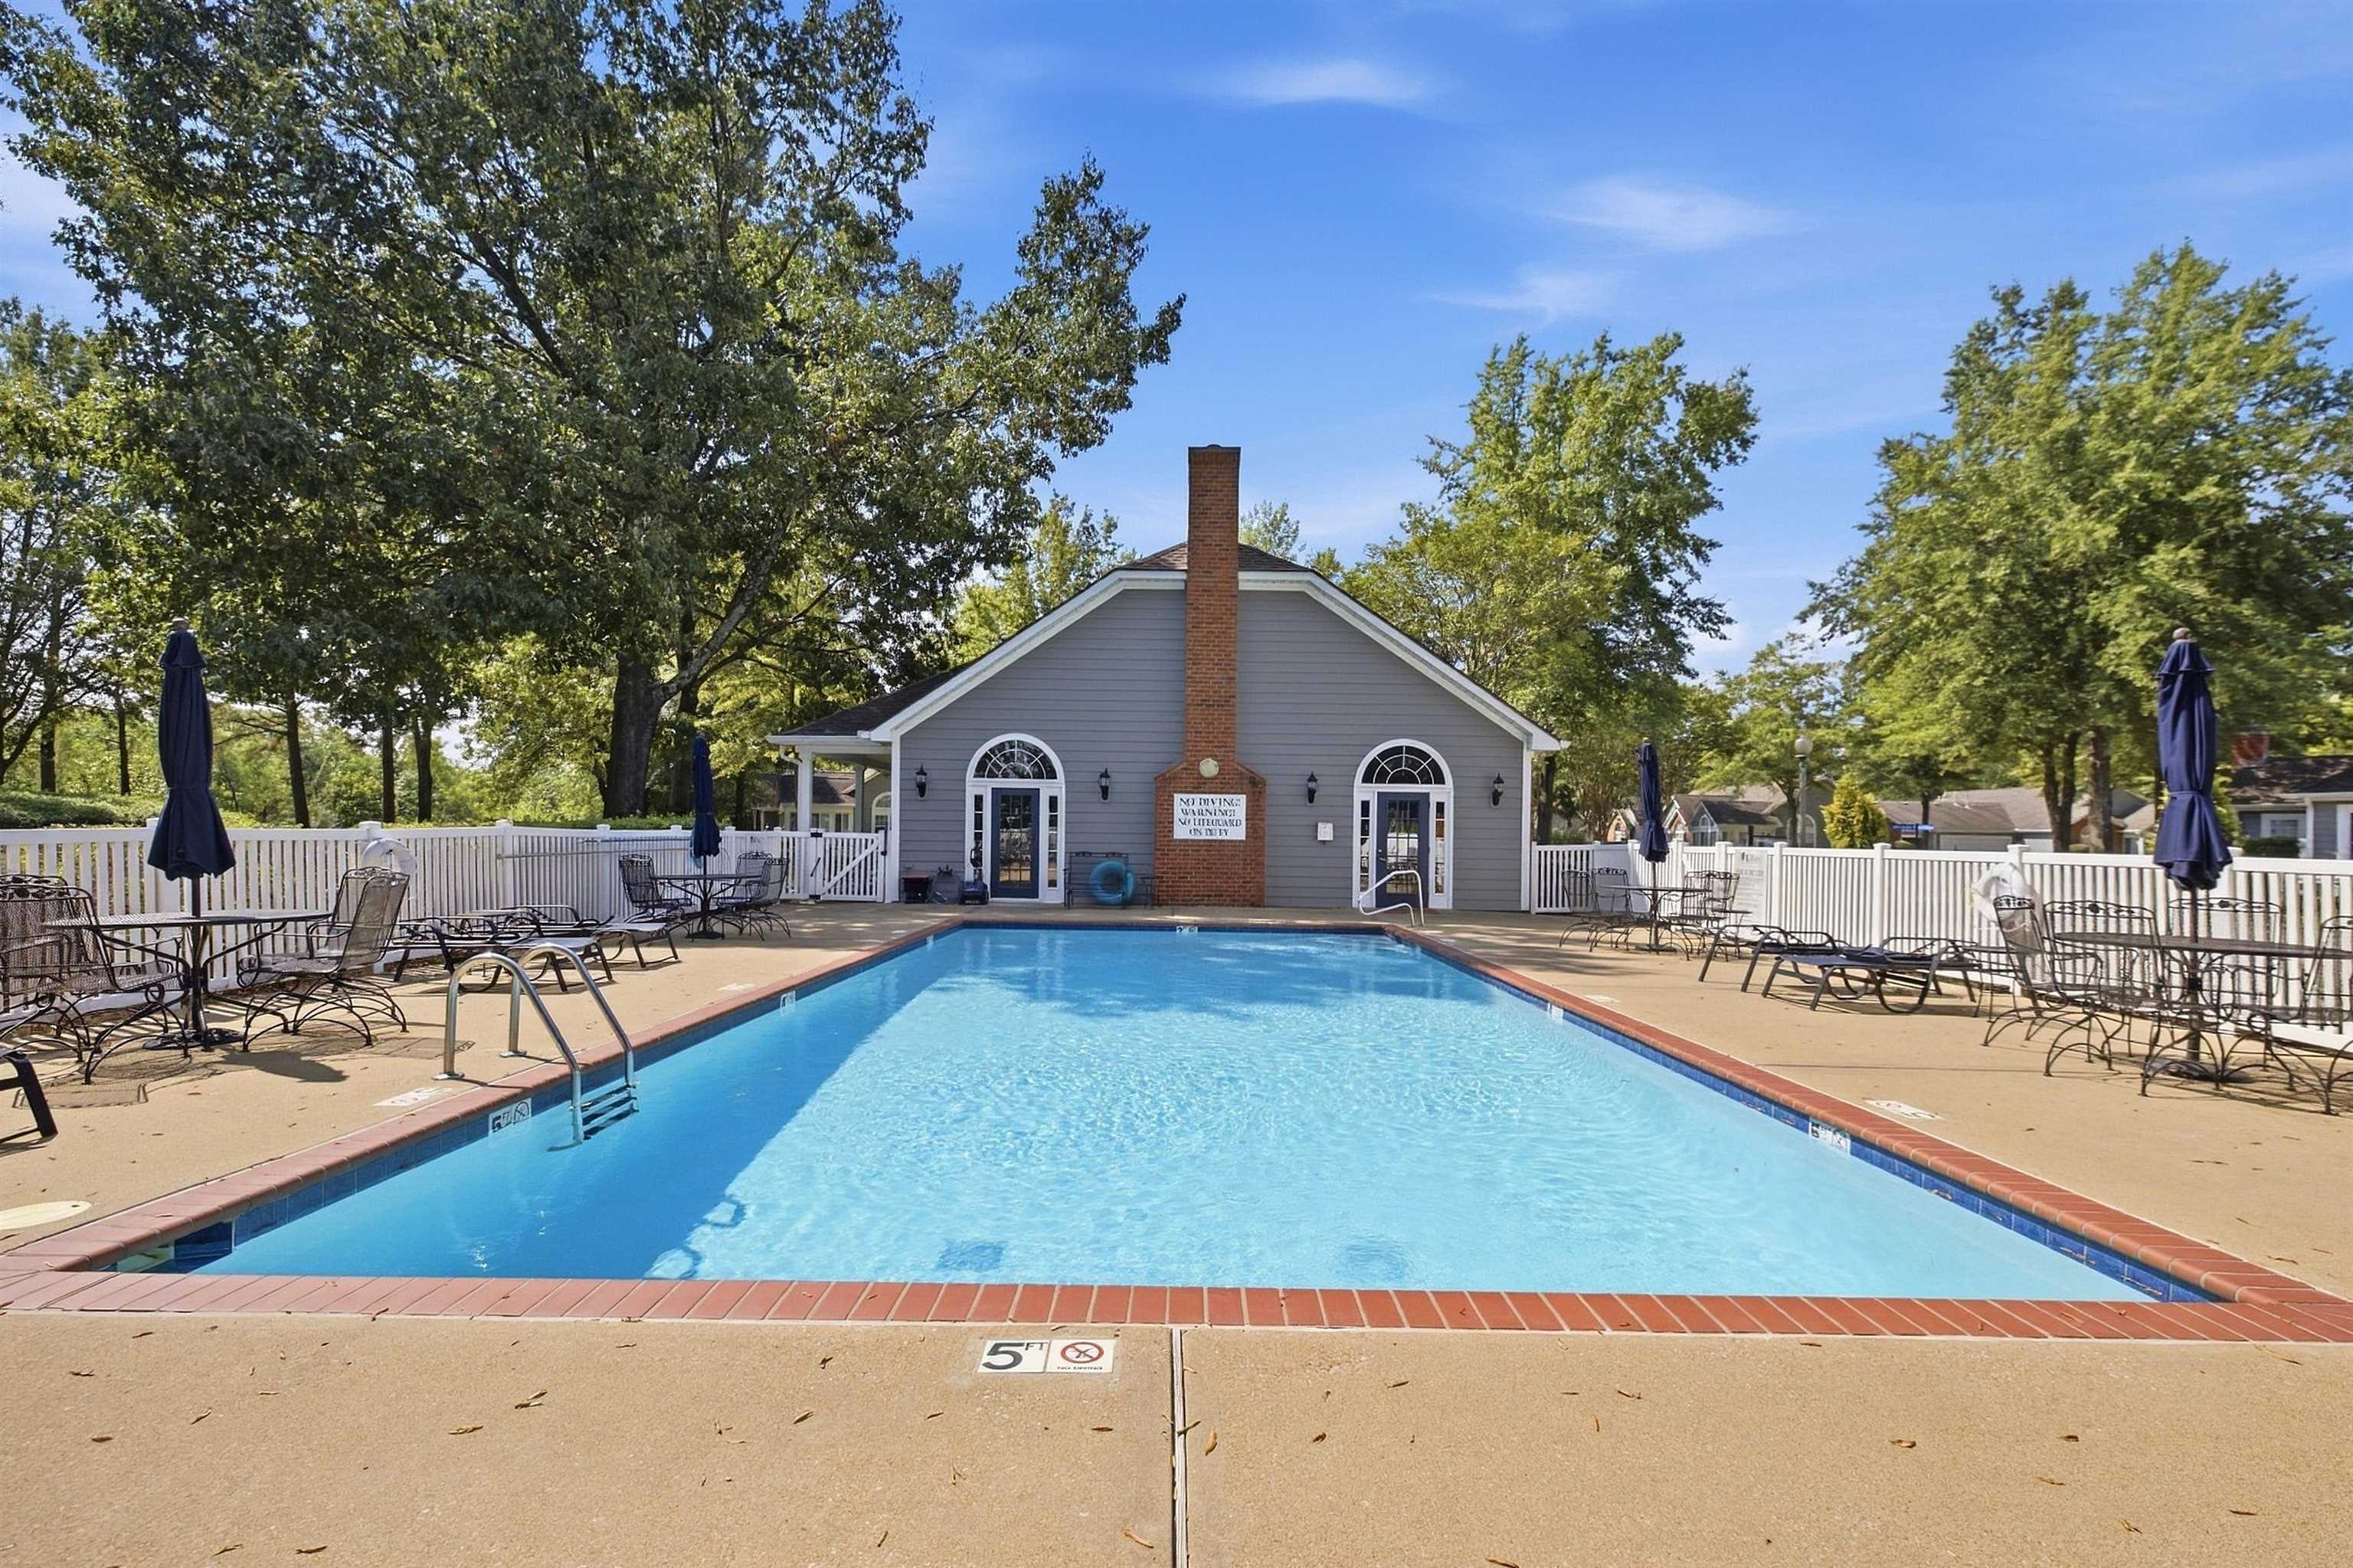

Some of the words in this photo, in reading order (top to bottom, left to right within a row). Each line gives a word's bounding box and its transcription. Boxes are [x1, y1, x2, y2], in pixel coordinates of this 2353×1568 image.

[1179, 797, 1195, 807] NO
[1181, 808, 1235, 817] WARNING!
[1178, 818, 1191, 827] NO
[1193, 818, 1242, 827] LIFEGUARD
[1189, 828, 1202, 836] ON
[1205, 828, 1229, 836] DUTY
